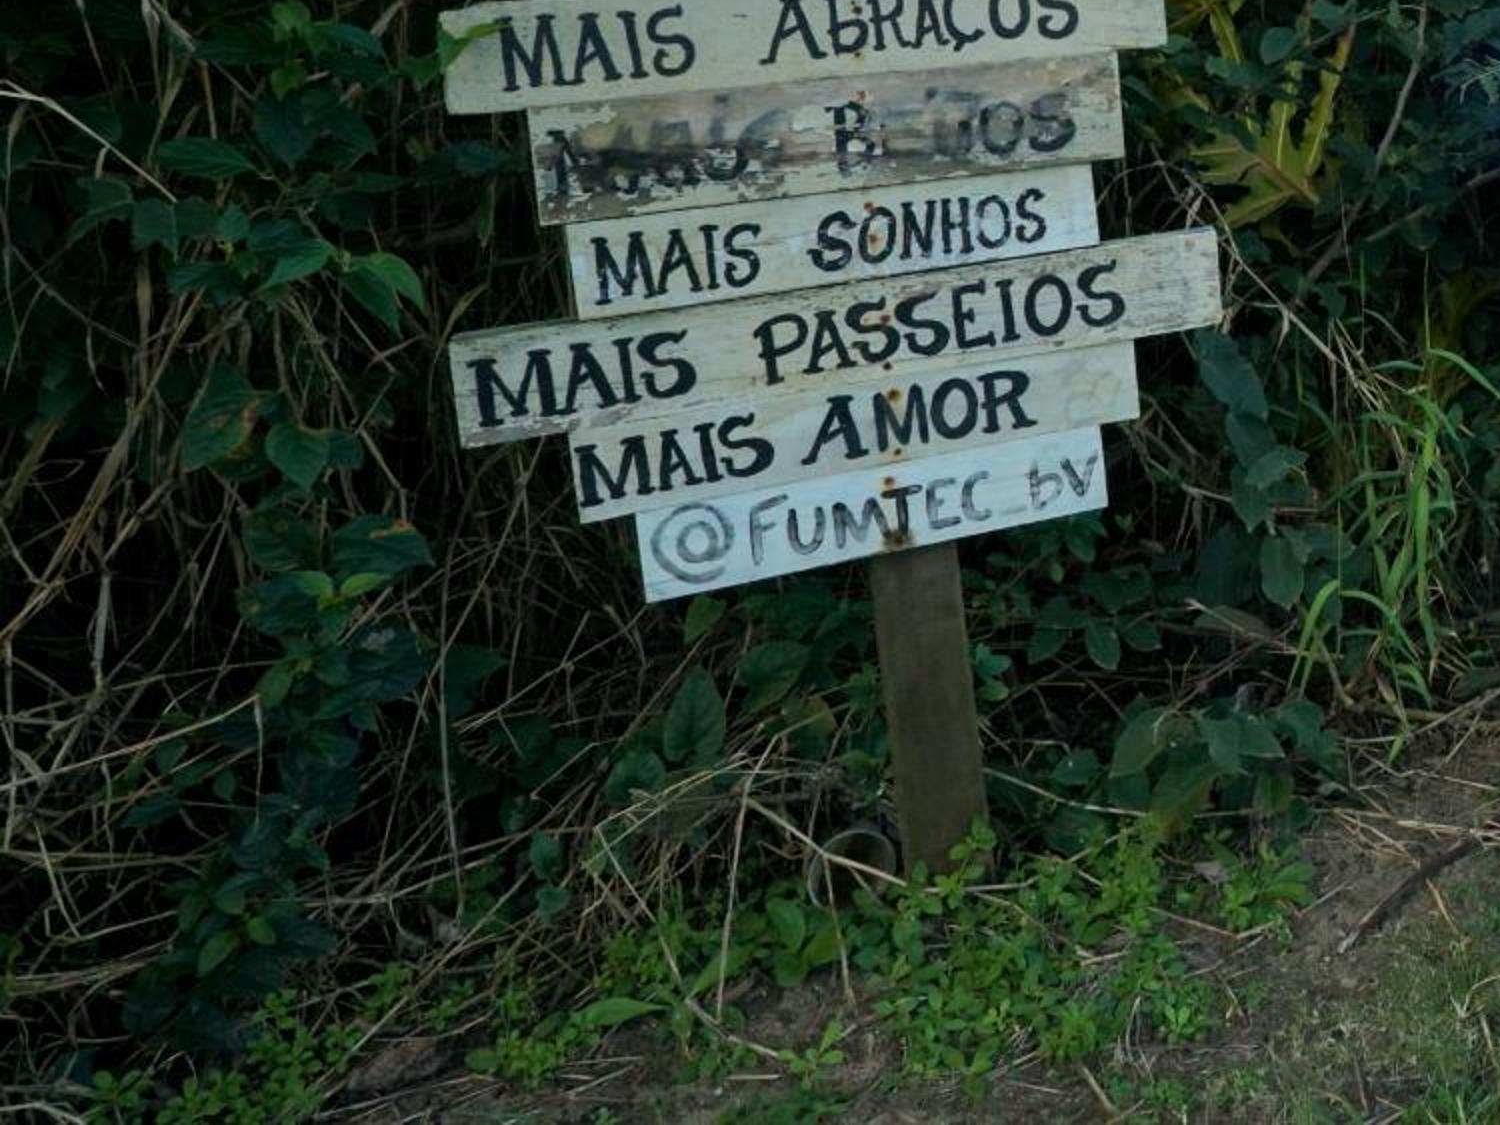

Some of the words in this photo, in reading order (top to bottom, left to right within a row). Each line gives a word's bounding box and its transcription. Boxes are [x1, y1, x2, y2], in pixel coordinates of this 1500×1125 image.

[499, 4, 697, 92] MAIS
[590, 222, 763, 306] MAIS
[806, 188, 1048, 272] SONHOS
[466, 328, 698, 430] MAIS
[753, 258, 1126, 387] PASSEIOS
[573, 411, 776, 509] MAIS
[800, 369, 1038, 467] AMOR
